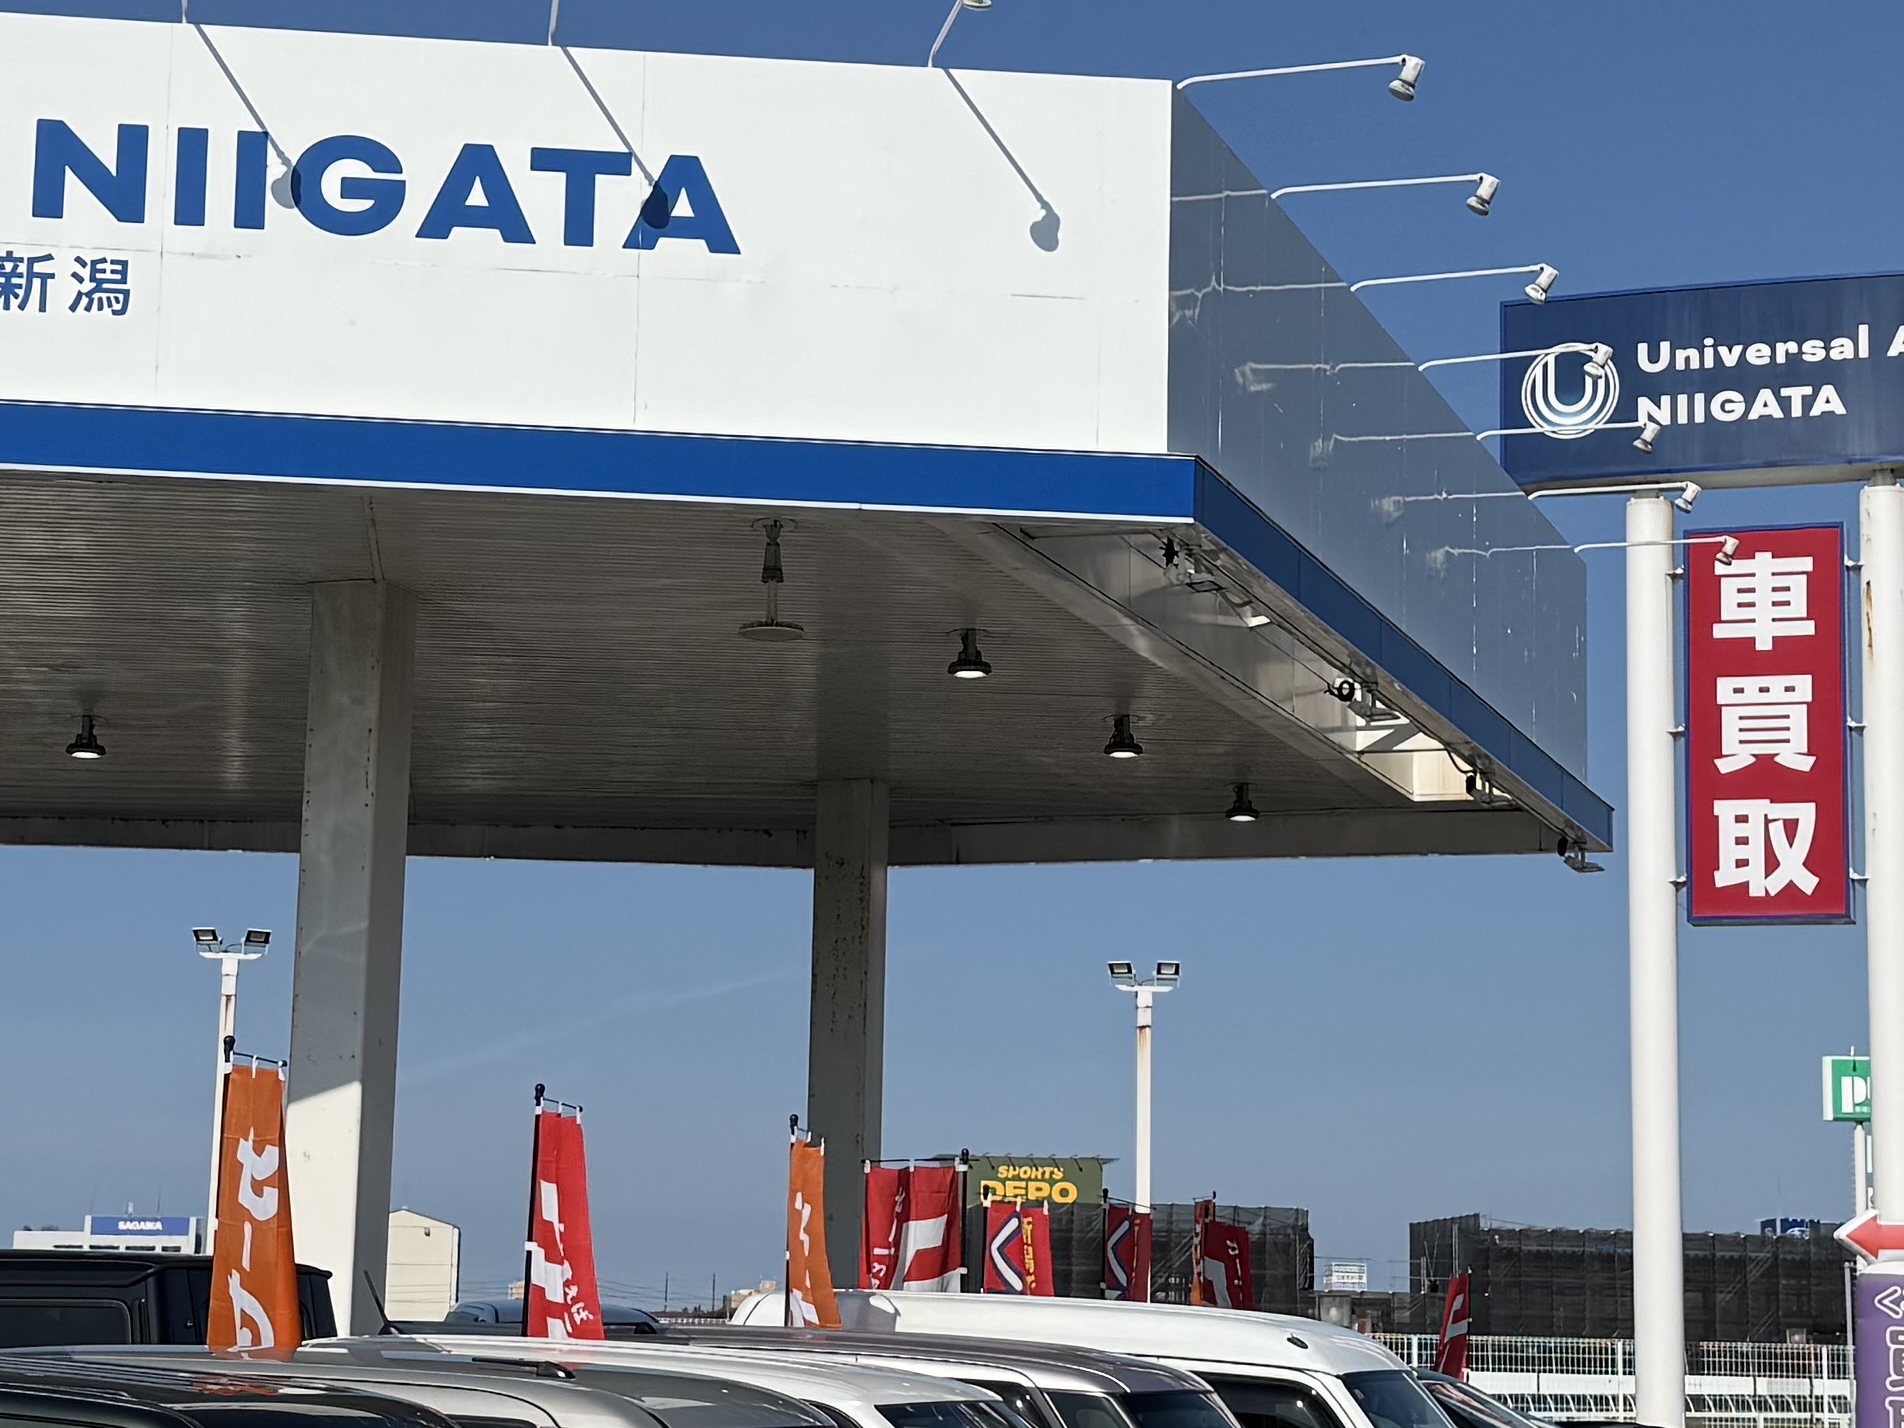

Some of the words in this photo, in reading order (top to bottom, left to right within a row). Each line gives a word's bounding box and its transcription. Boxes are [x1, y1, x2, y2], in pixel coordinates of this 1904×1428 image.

[31, 118, 743, 255] NIIGATA
[1637, 324, 1870, 373] Universal
[1637, 384, 1847, 426] NIIGATA
[1712, 552, 1820, 897] 車買取
[981, 1180, 1078, 1204] DEPO
[997, 1165, 1064, 1180] SPORTS
